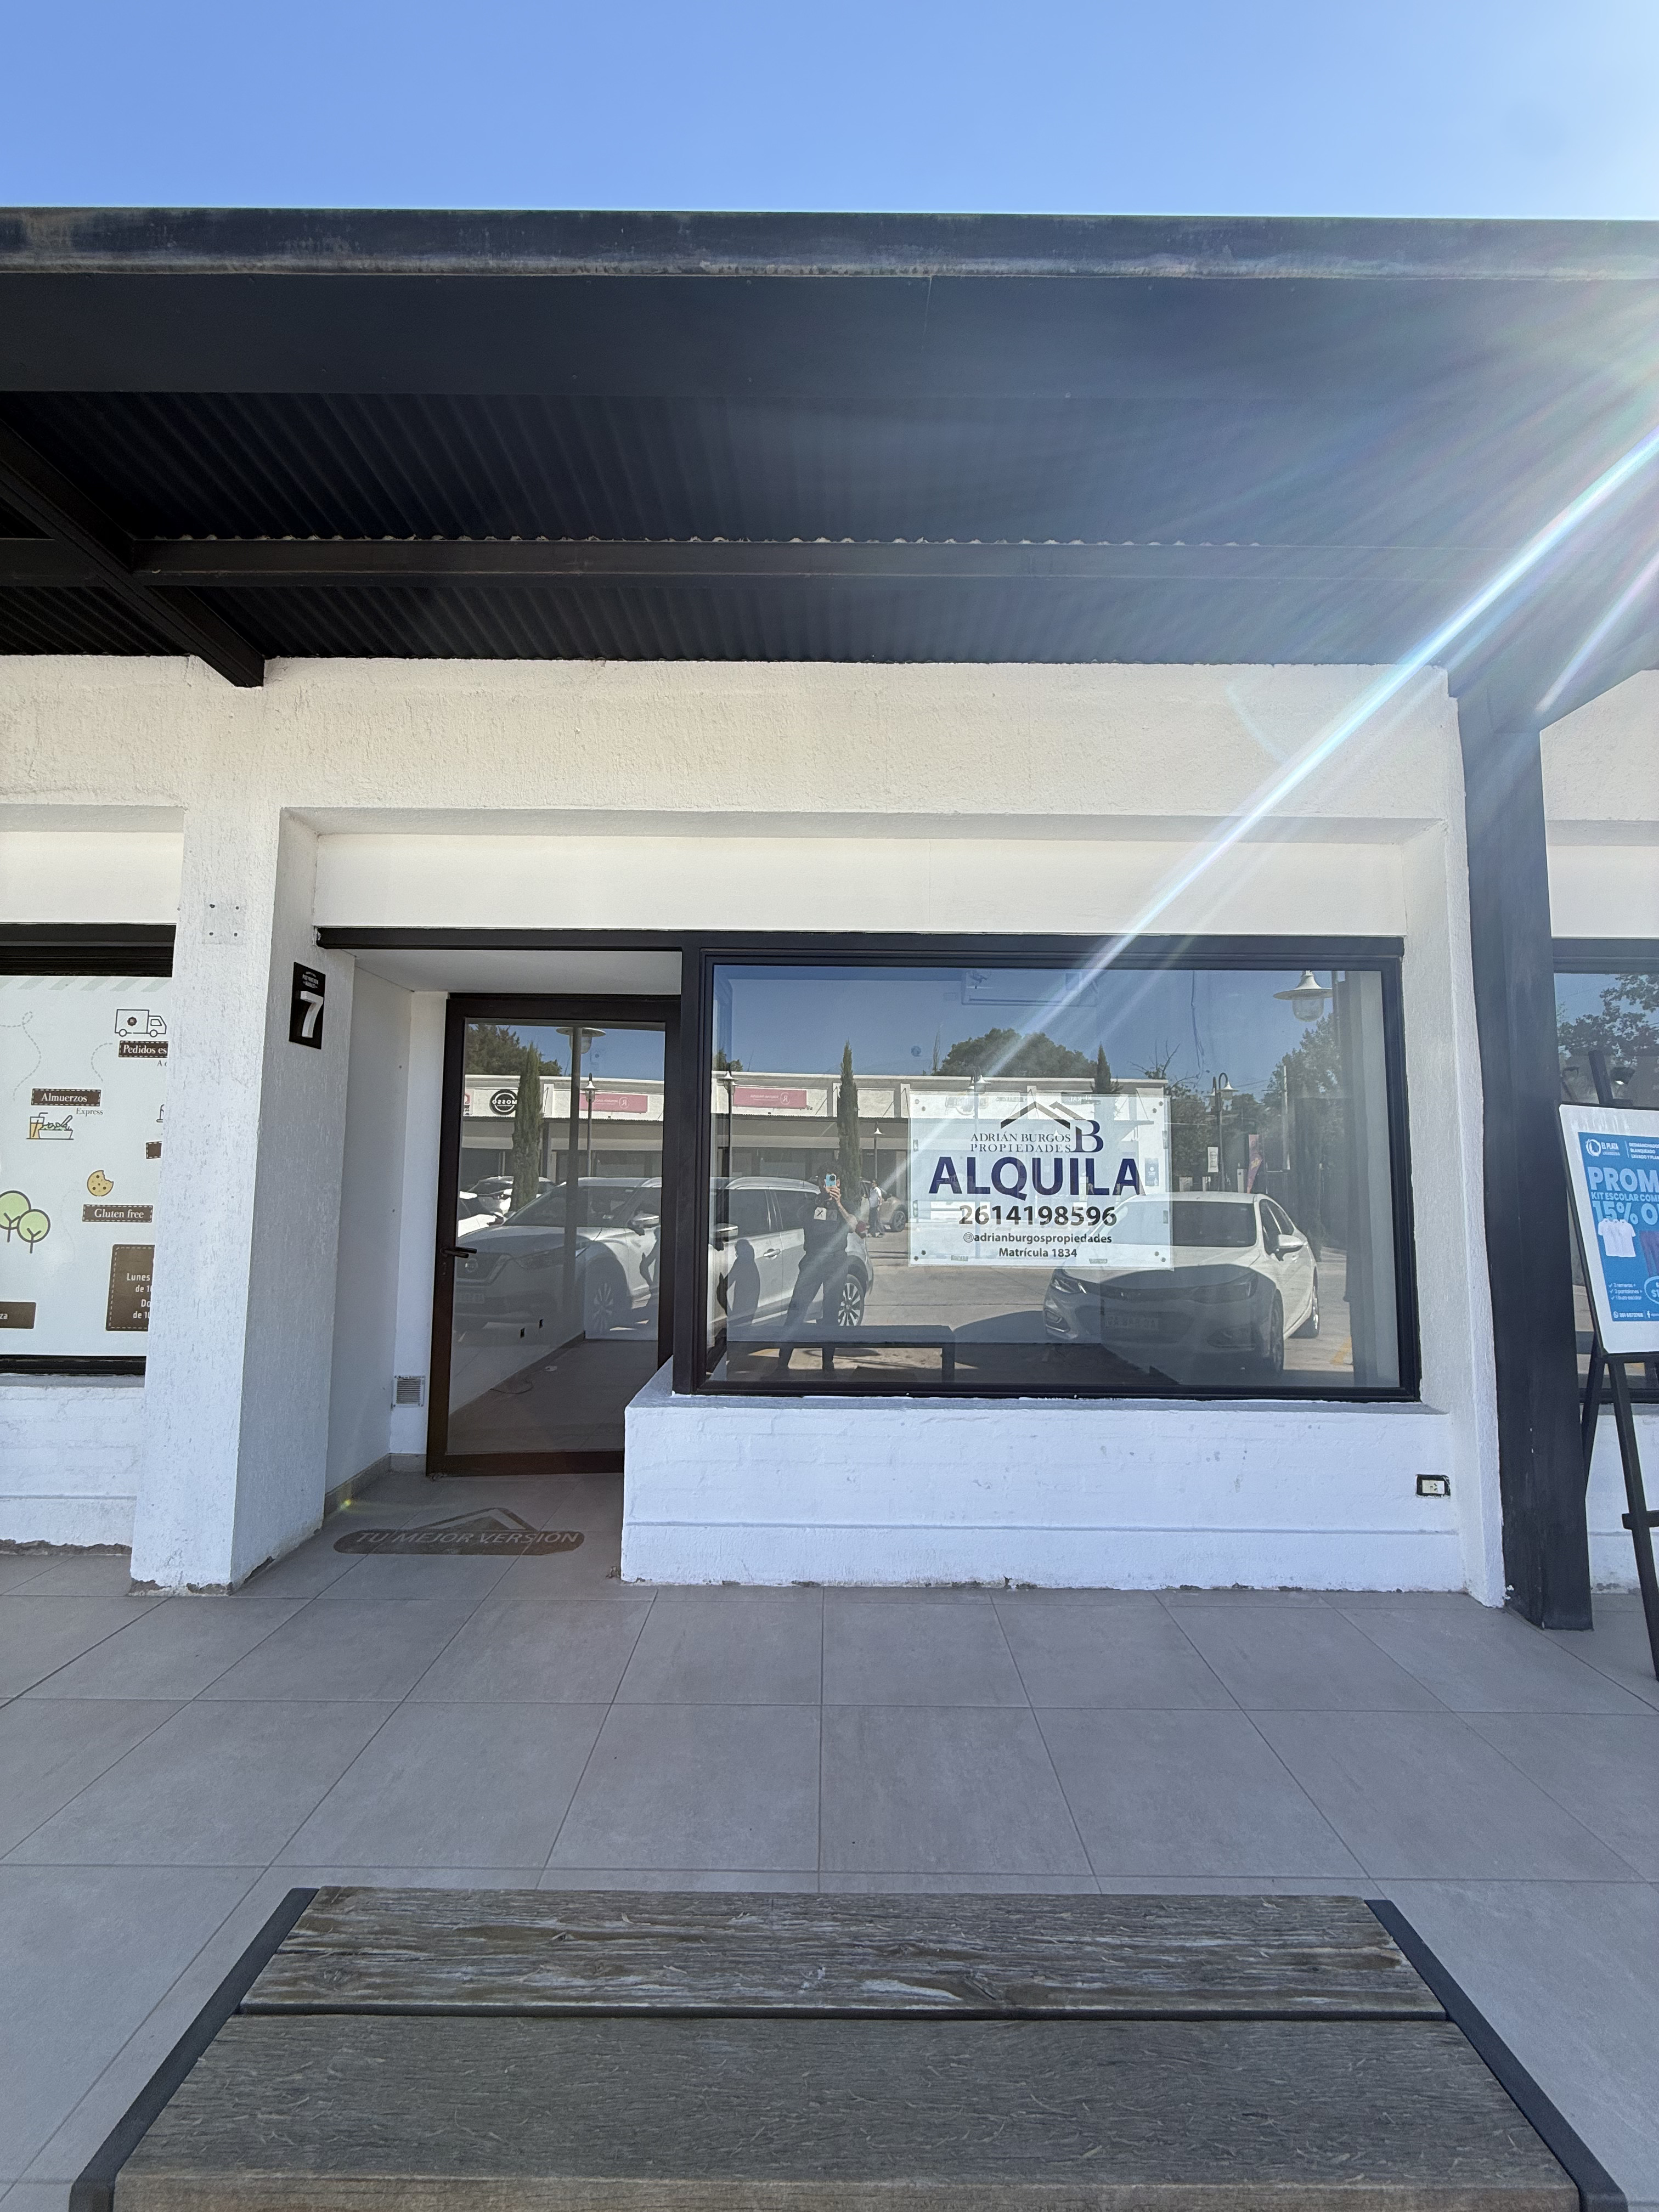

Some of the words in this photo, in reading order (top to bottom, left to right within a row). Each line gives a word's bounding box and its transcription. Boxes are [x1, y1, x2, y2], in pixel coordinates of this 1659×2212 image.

[300, 990, 324, 1038] 7
[123, 1045, 156, 1054] Pedidos
[41, 1093, 88, 1103] Almuerzos
[76, 1108, 104, 1116] Express
[970, 1131, 1017, 1142] ADRIÁN
[1021, 1133, 1071, 1142] BURGOS
[1071, 1120, 1104, 1153] B
[970, 1143, 1071, 1153] PROPIEDADES
[928, 1156, 1146, 1201] ALQUILA
[1591, 1192, 1604, 1200] KIT
[1605, 1192, 1639, 1201] ESCOLAR
[1639, 1194, 1659, 1202] COM
[94, 1209, 125, 1218] Gluten
[127, 1209, 144, 1218] free
[958, 1205, 1117, 1226] 2614198596
[1592, 1200, 1639, 1225] 15%
[1641, 1203, 1659, 1225] O
[999, 1248, 1048, 1257] Matrícula
[1052, 1249, 1077, 1257] 1834
[126, 1273, 150, 1282] Lunes
[133, 1311, 142, 1319] de
[357, 1533, 391, 1543] TU
[391, 1533, 474, 1543] MEJOR
[479, 1533, 579, 1543] VERSION
